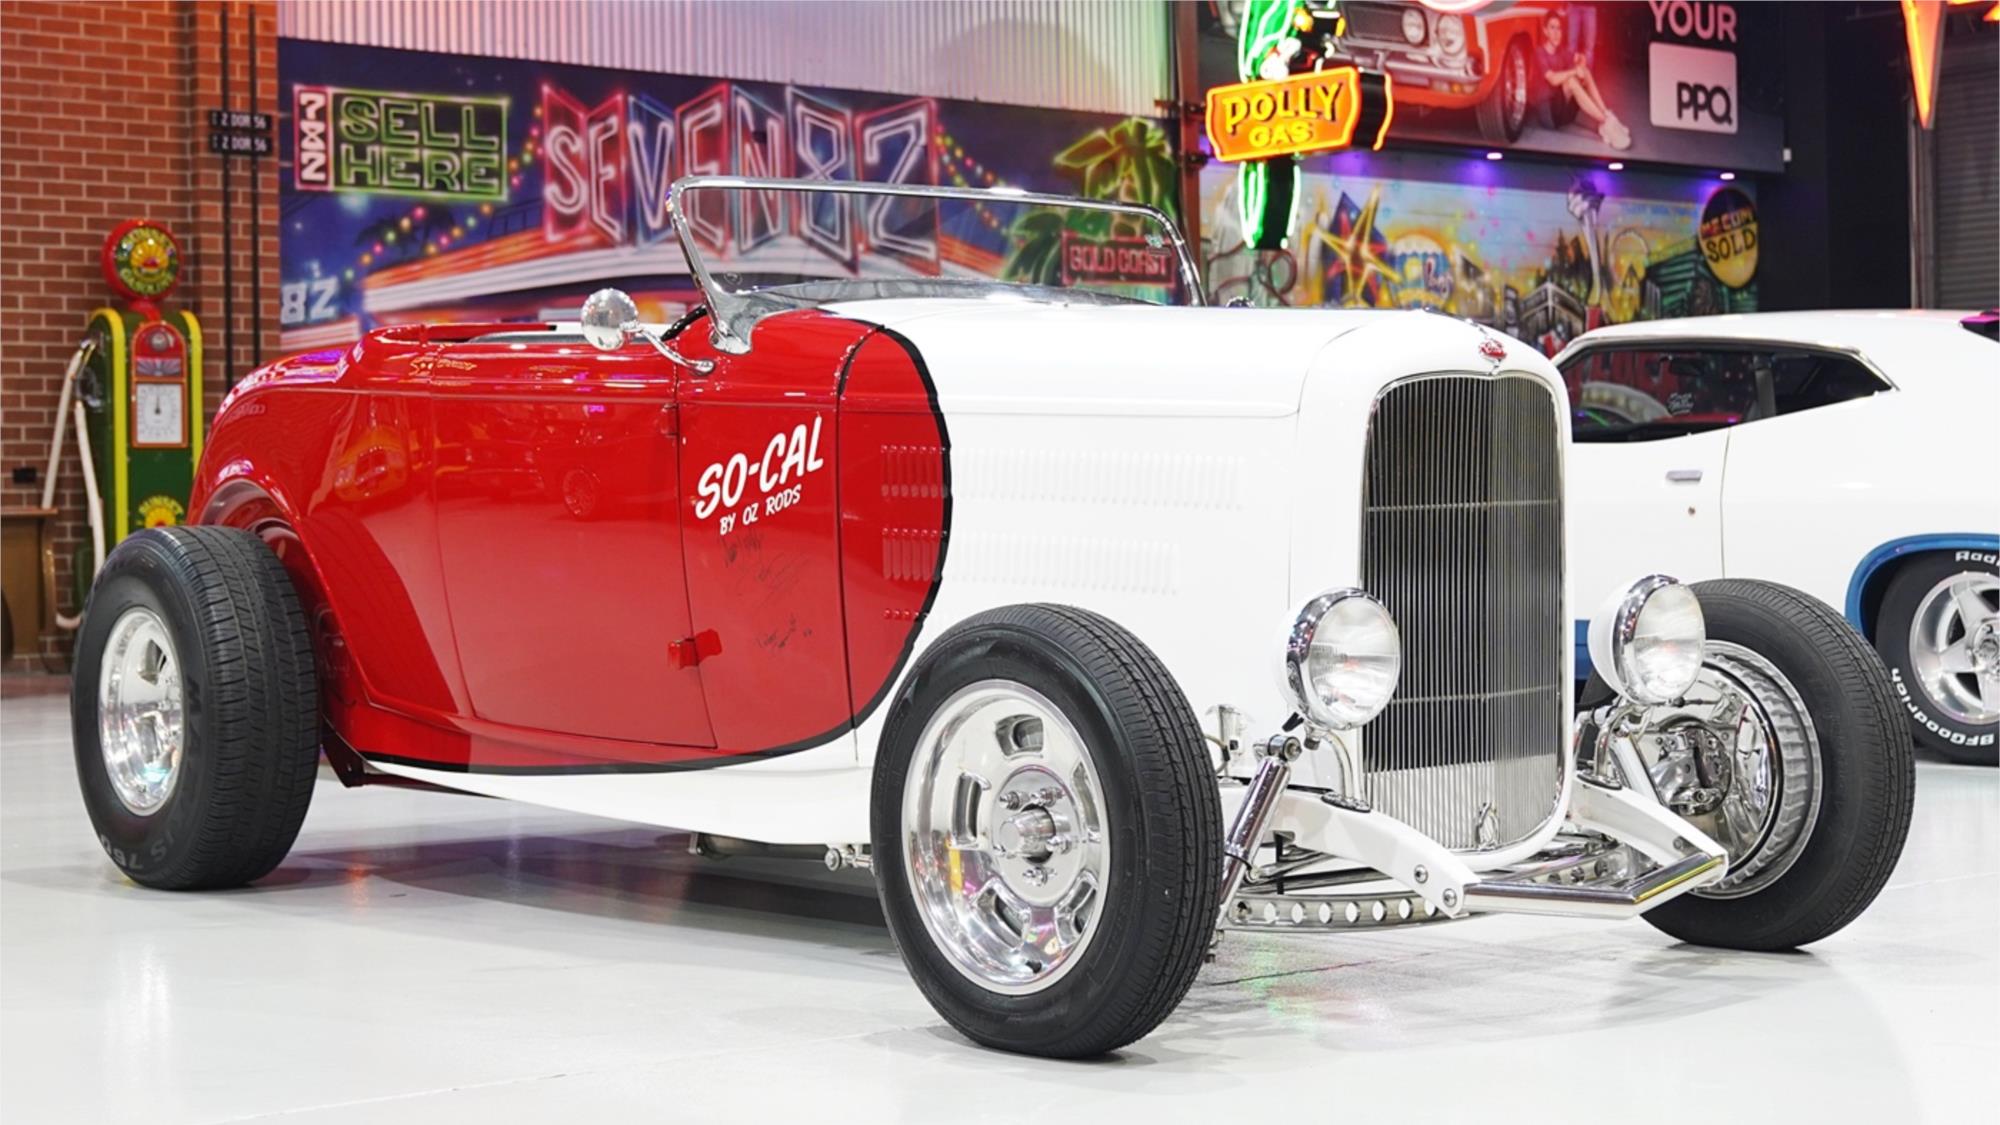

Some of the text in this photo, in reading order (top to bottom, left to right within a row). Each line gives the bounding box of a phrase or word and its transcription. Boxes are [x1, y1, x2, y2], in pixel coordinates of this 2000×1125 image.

[1648, 0, 1737, 42] YOUR
[340, 97, 499, 149] SELL
[1222, 82, 1342, 134] POLLY
[1677, 81, 1733, 125] PPQ
[1248, 120, 1312, 147] GAS
[340, 143, 499, 194] HERE
[1070, 245, 1115, 272] GOLD
[1119, 247, 1166, 275] COAST
[1706, 228, 1756, 263] SOLD
[696, 415, 823, 519] SO-CAL
[720, 484, 802, 535] BY OZ RODS
[1891, 668, 1994, 746] BFGoodrich
